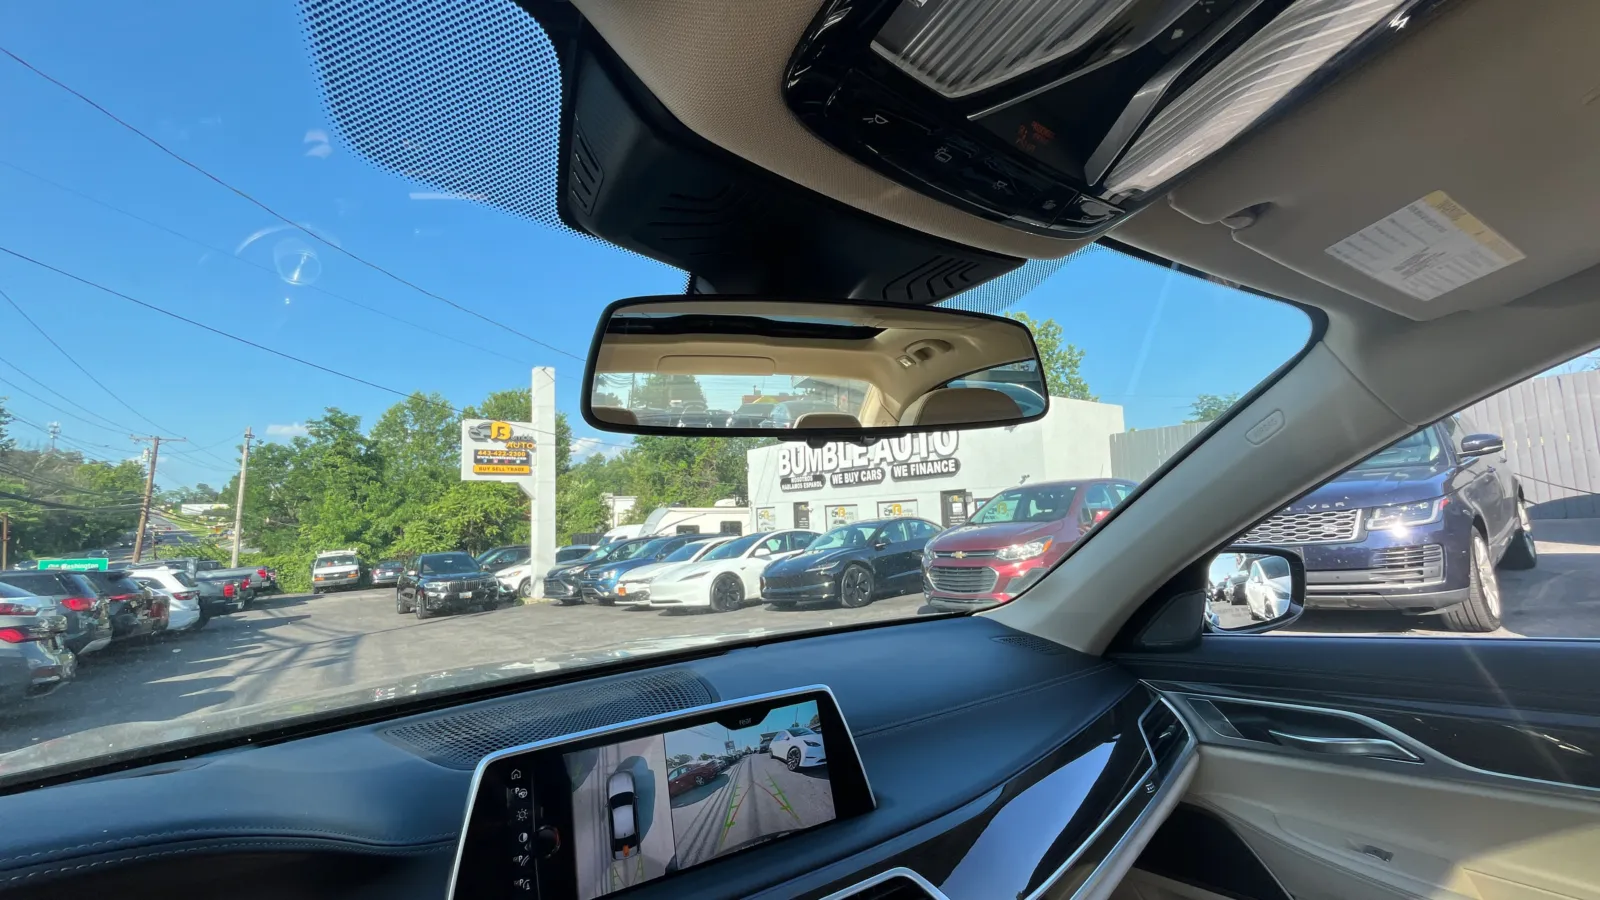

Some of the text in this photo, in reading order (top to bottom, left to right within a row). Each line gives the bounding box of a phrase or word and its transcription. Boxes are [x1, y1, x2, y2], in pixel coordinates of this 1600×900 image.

[505, 441, 534, 449] AUTO
[778, 431, 959, 476] BUMBLE AUTO
[832, 469, 882, 485] WE BUY CARS
[893, 459, 956, 478] WE FINANCE
